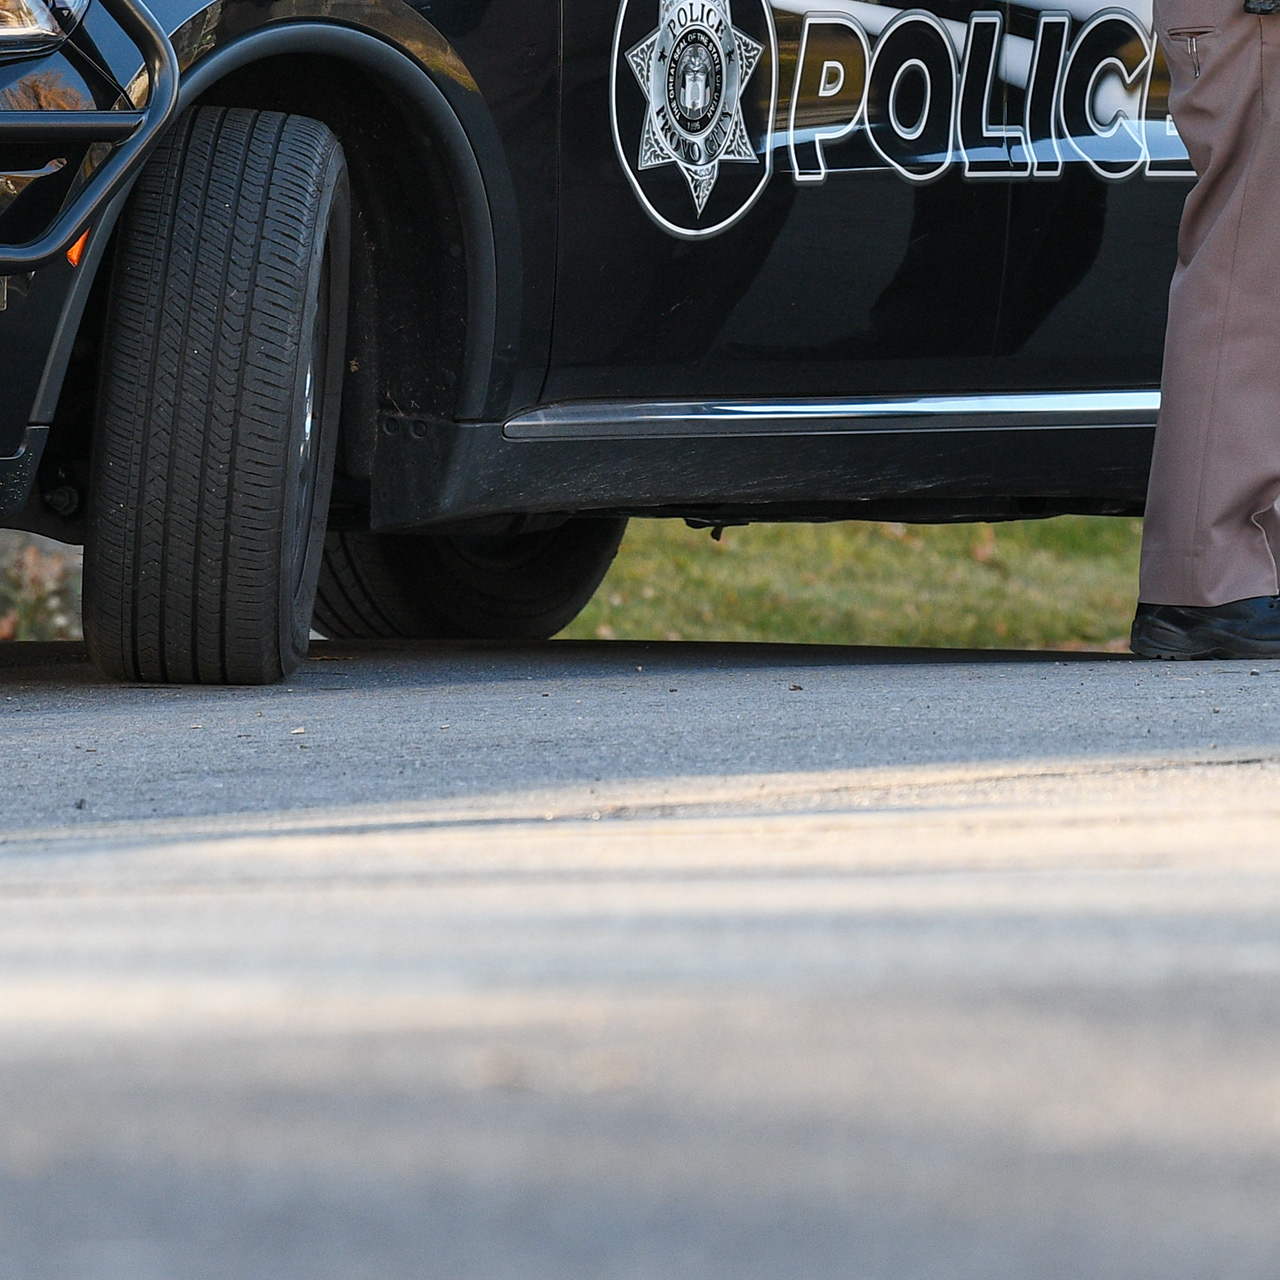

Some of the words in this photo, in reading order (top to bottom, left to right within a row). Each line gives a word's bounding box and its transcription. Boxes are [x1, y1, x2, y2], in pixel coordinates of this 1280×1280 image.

[666, 2, 728, 41] POLICE
[673, 39, 688, 60] SEAL
[696, 32, 709, 46] THE
[708, 42, 721, 73] STATE
[656, 105, 702, 162] PROVO
[704, 102, 732, 157] CITY
